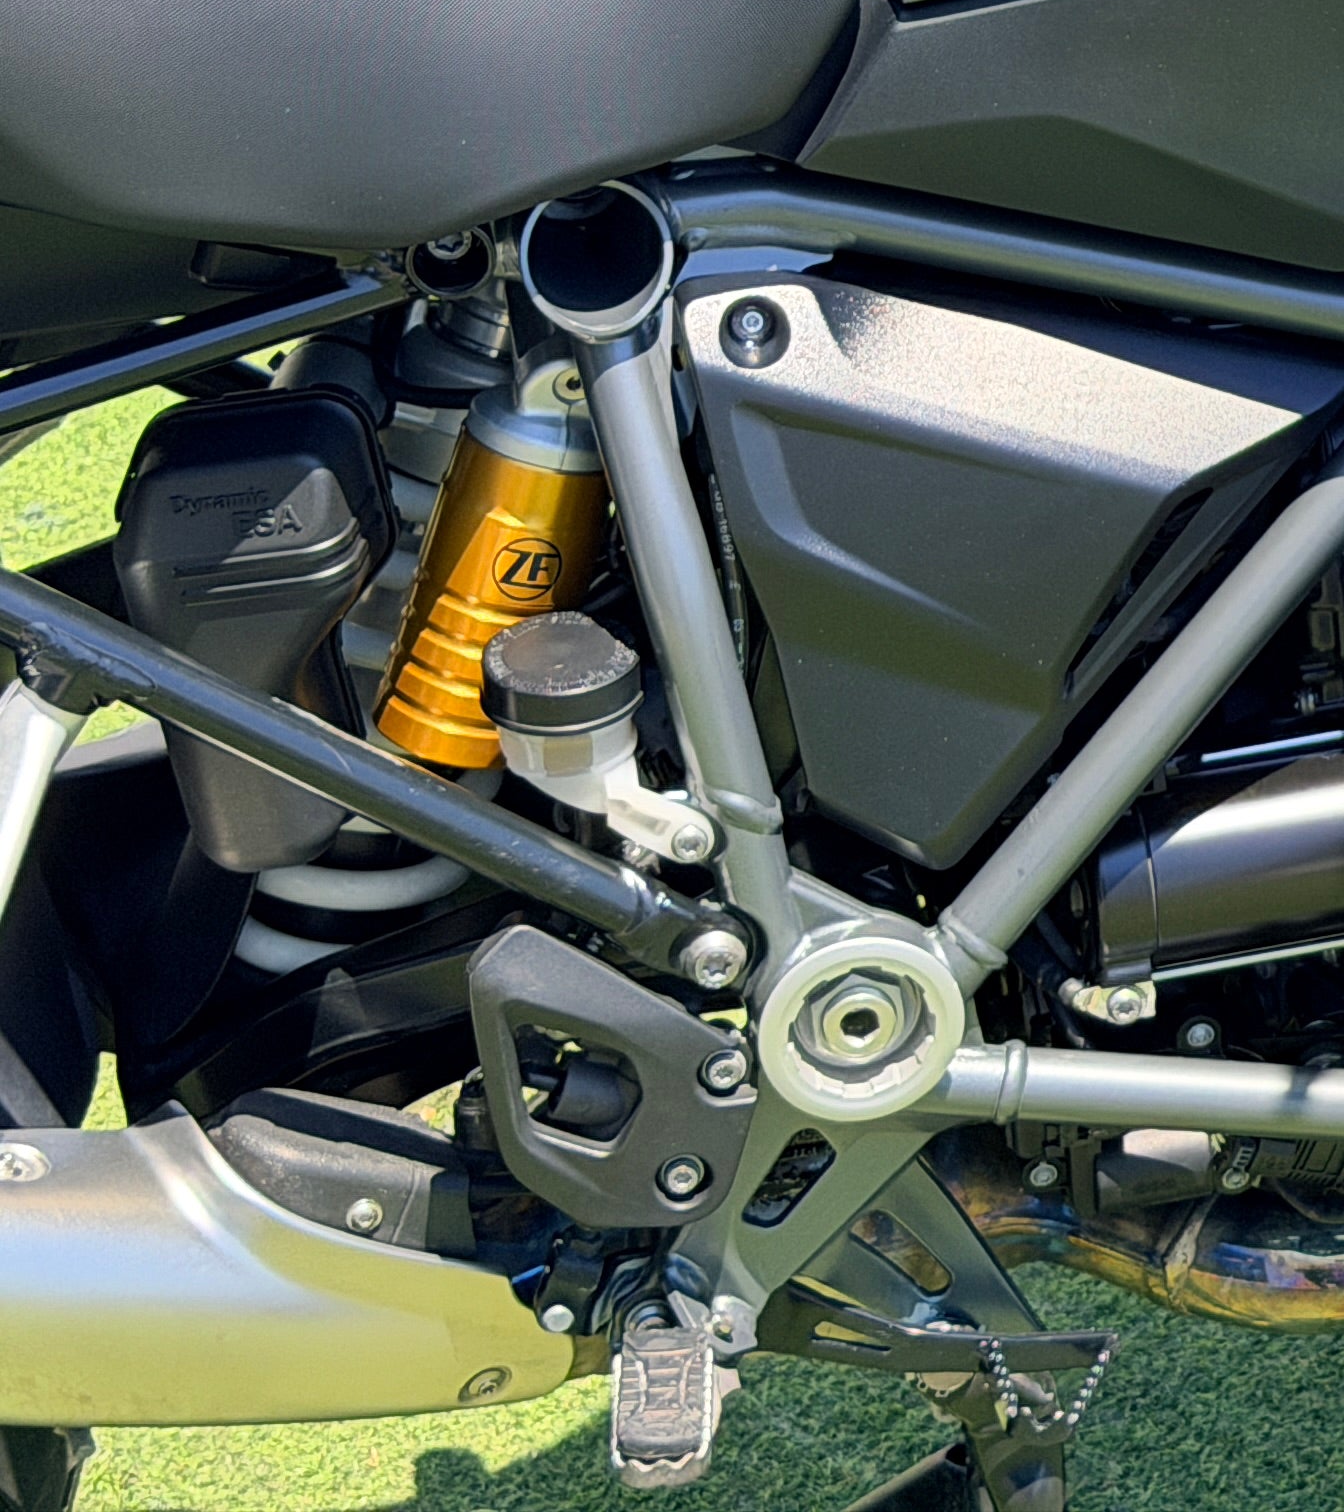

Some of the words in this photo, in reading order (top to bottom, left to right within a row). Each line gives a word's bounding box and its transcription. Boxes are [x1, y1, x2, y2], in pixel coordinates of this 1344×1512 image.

[169, 487, 270, 516] Dynamic
[231, 503, 303, 538] ESA
[498, 546, 562, 590] ZF
